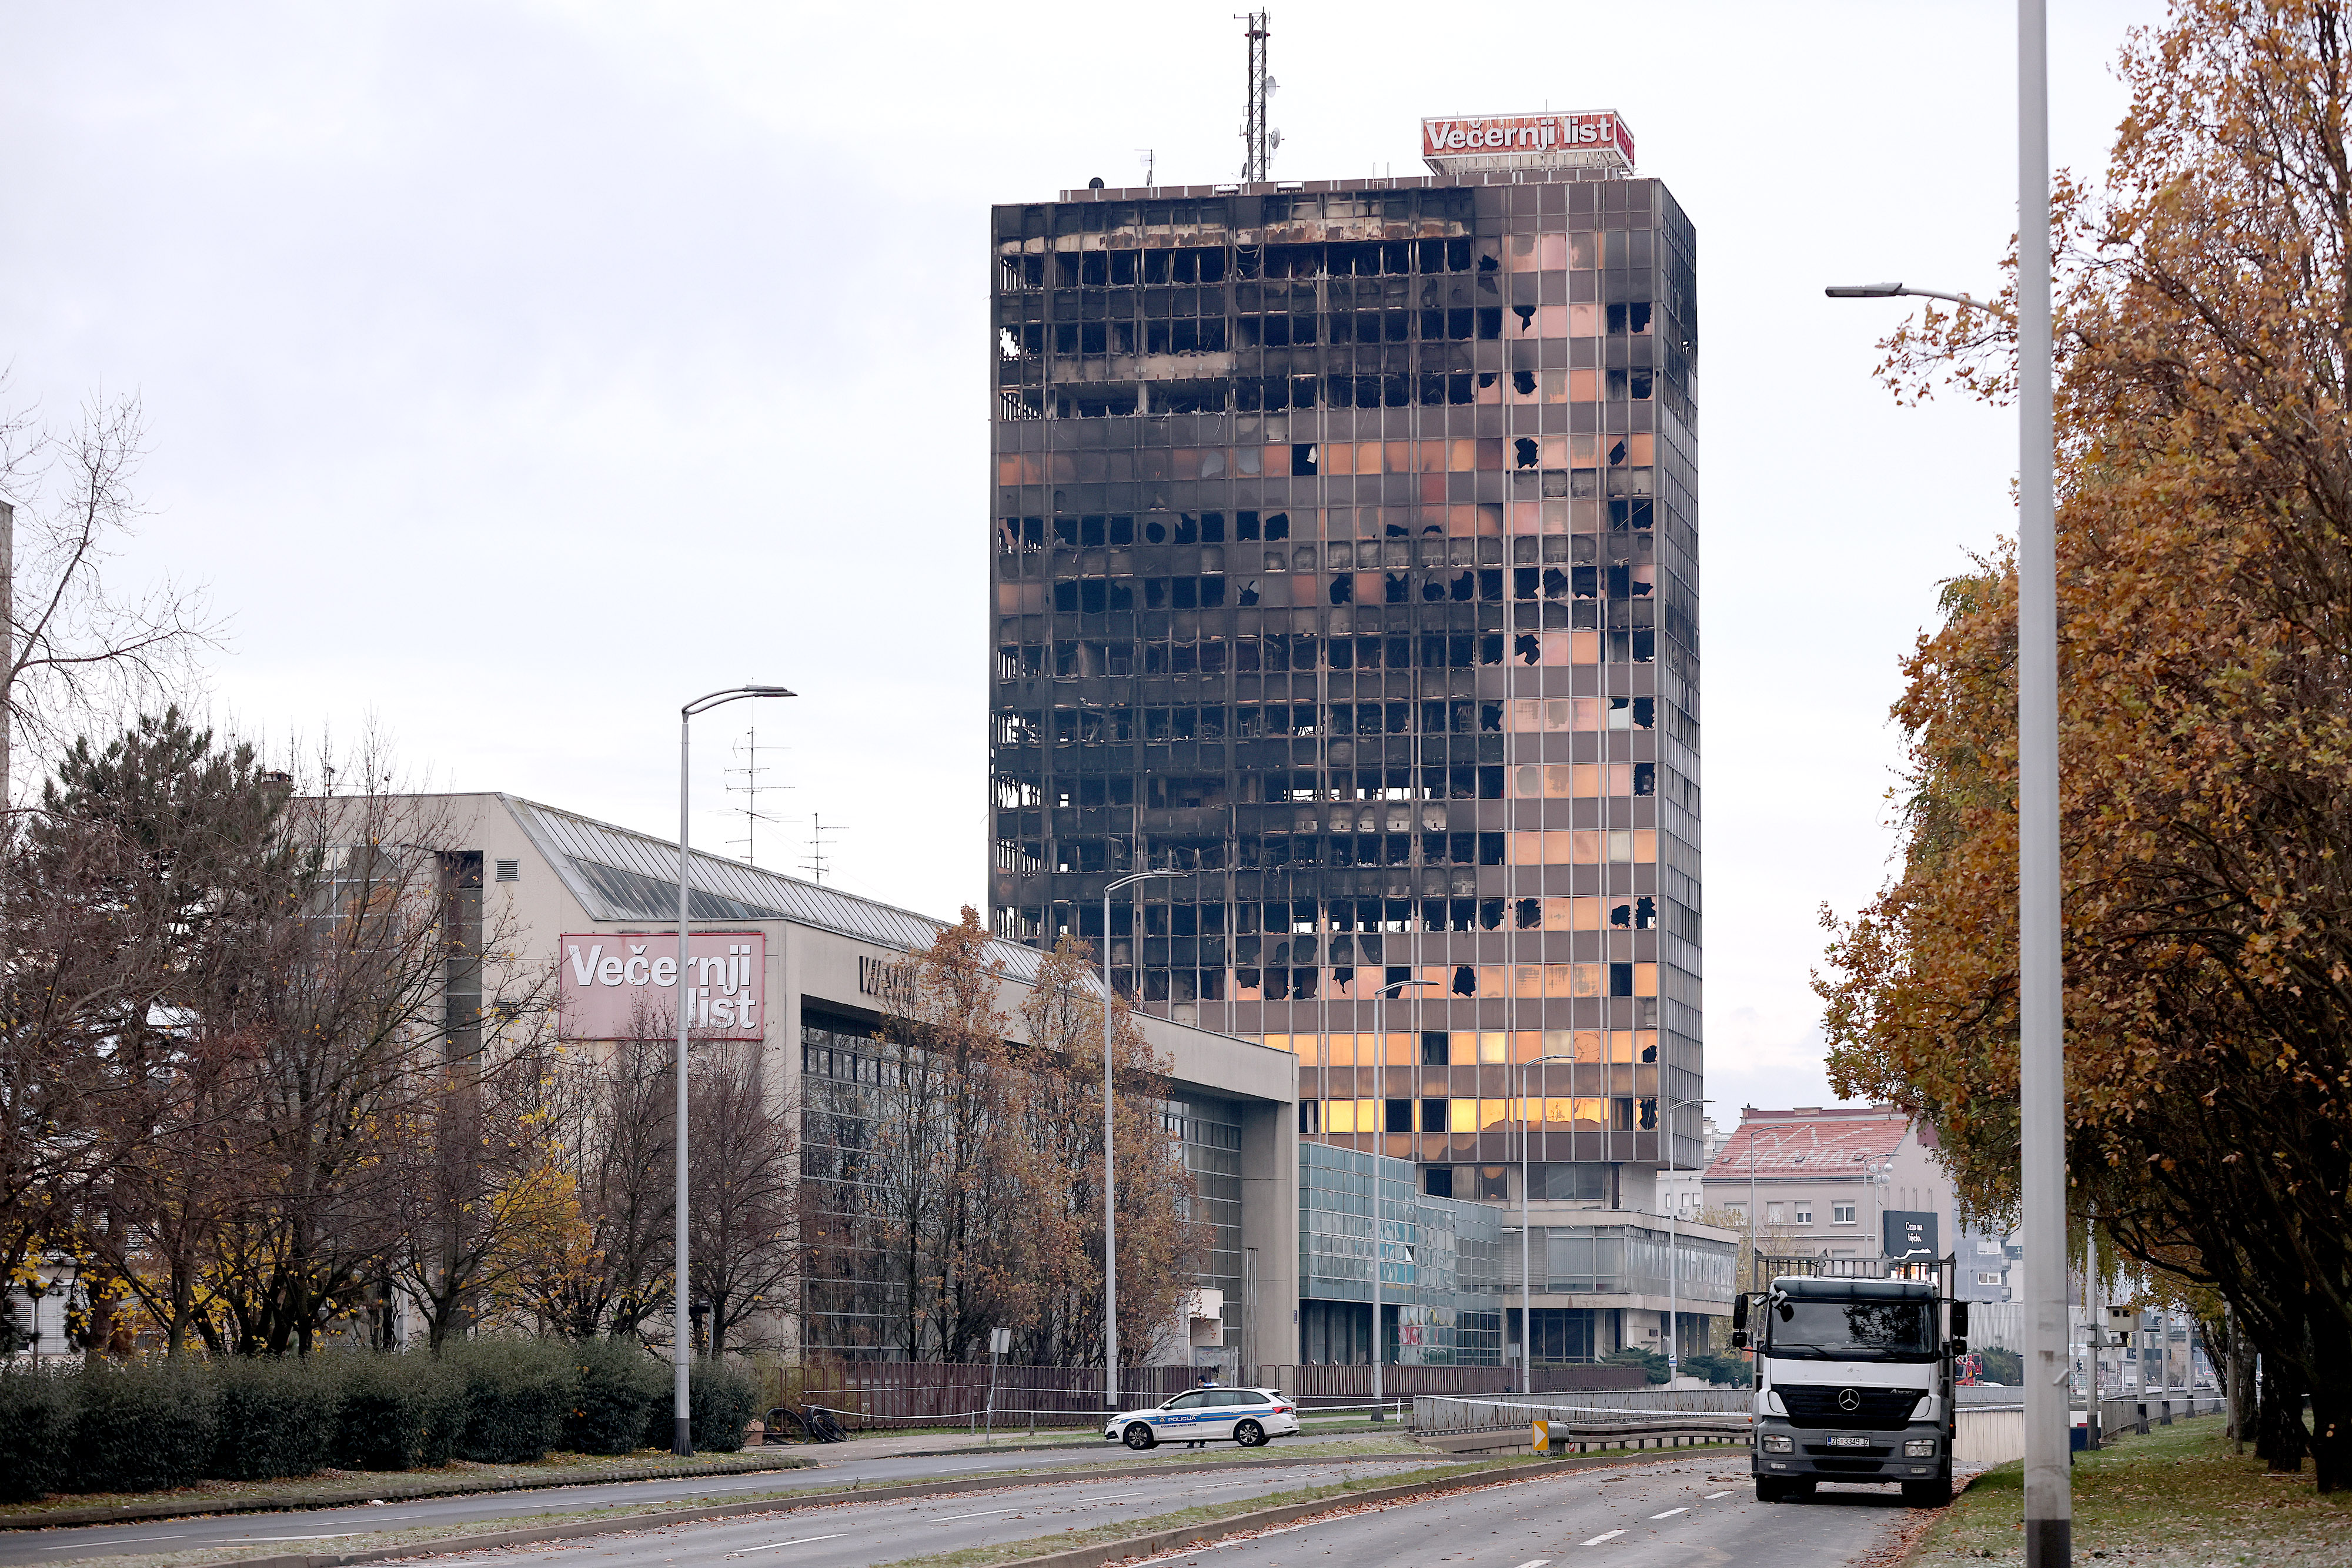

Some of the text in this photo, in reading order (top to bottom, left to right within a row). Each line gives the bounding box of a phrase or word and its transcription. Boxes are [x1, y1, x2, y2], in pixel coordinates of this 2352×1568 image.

[1426, 118, 1555, 151] Večernji
[1564, 117, 1612, 143] list
[567, 944, 751, 996] Večenji
[687, 988, 756, 1029] list
